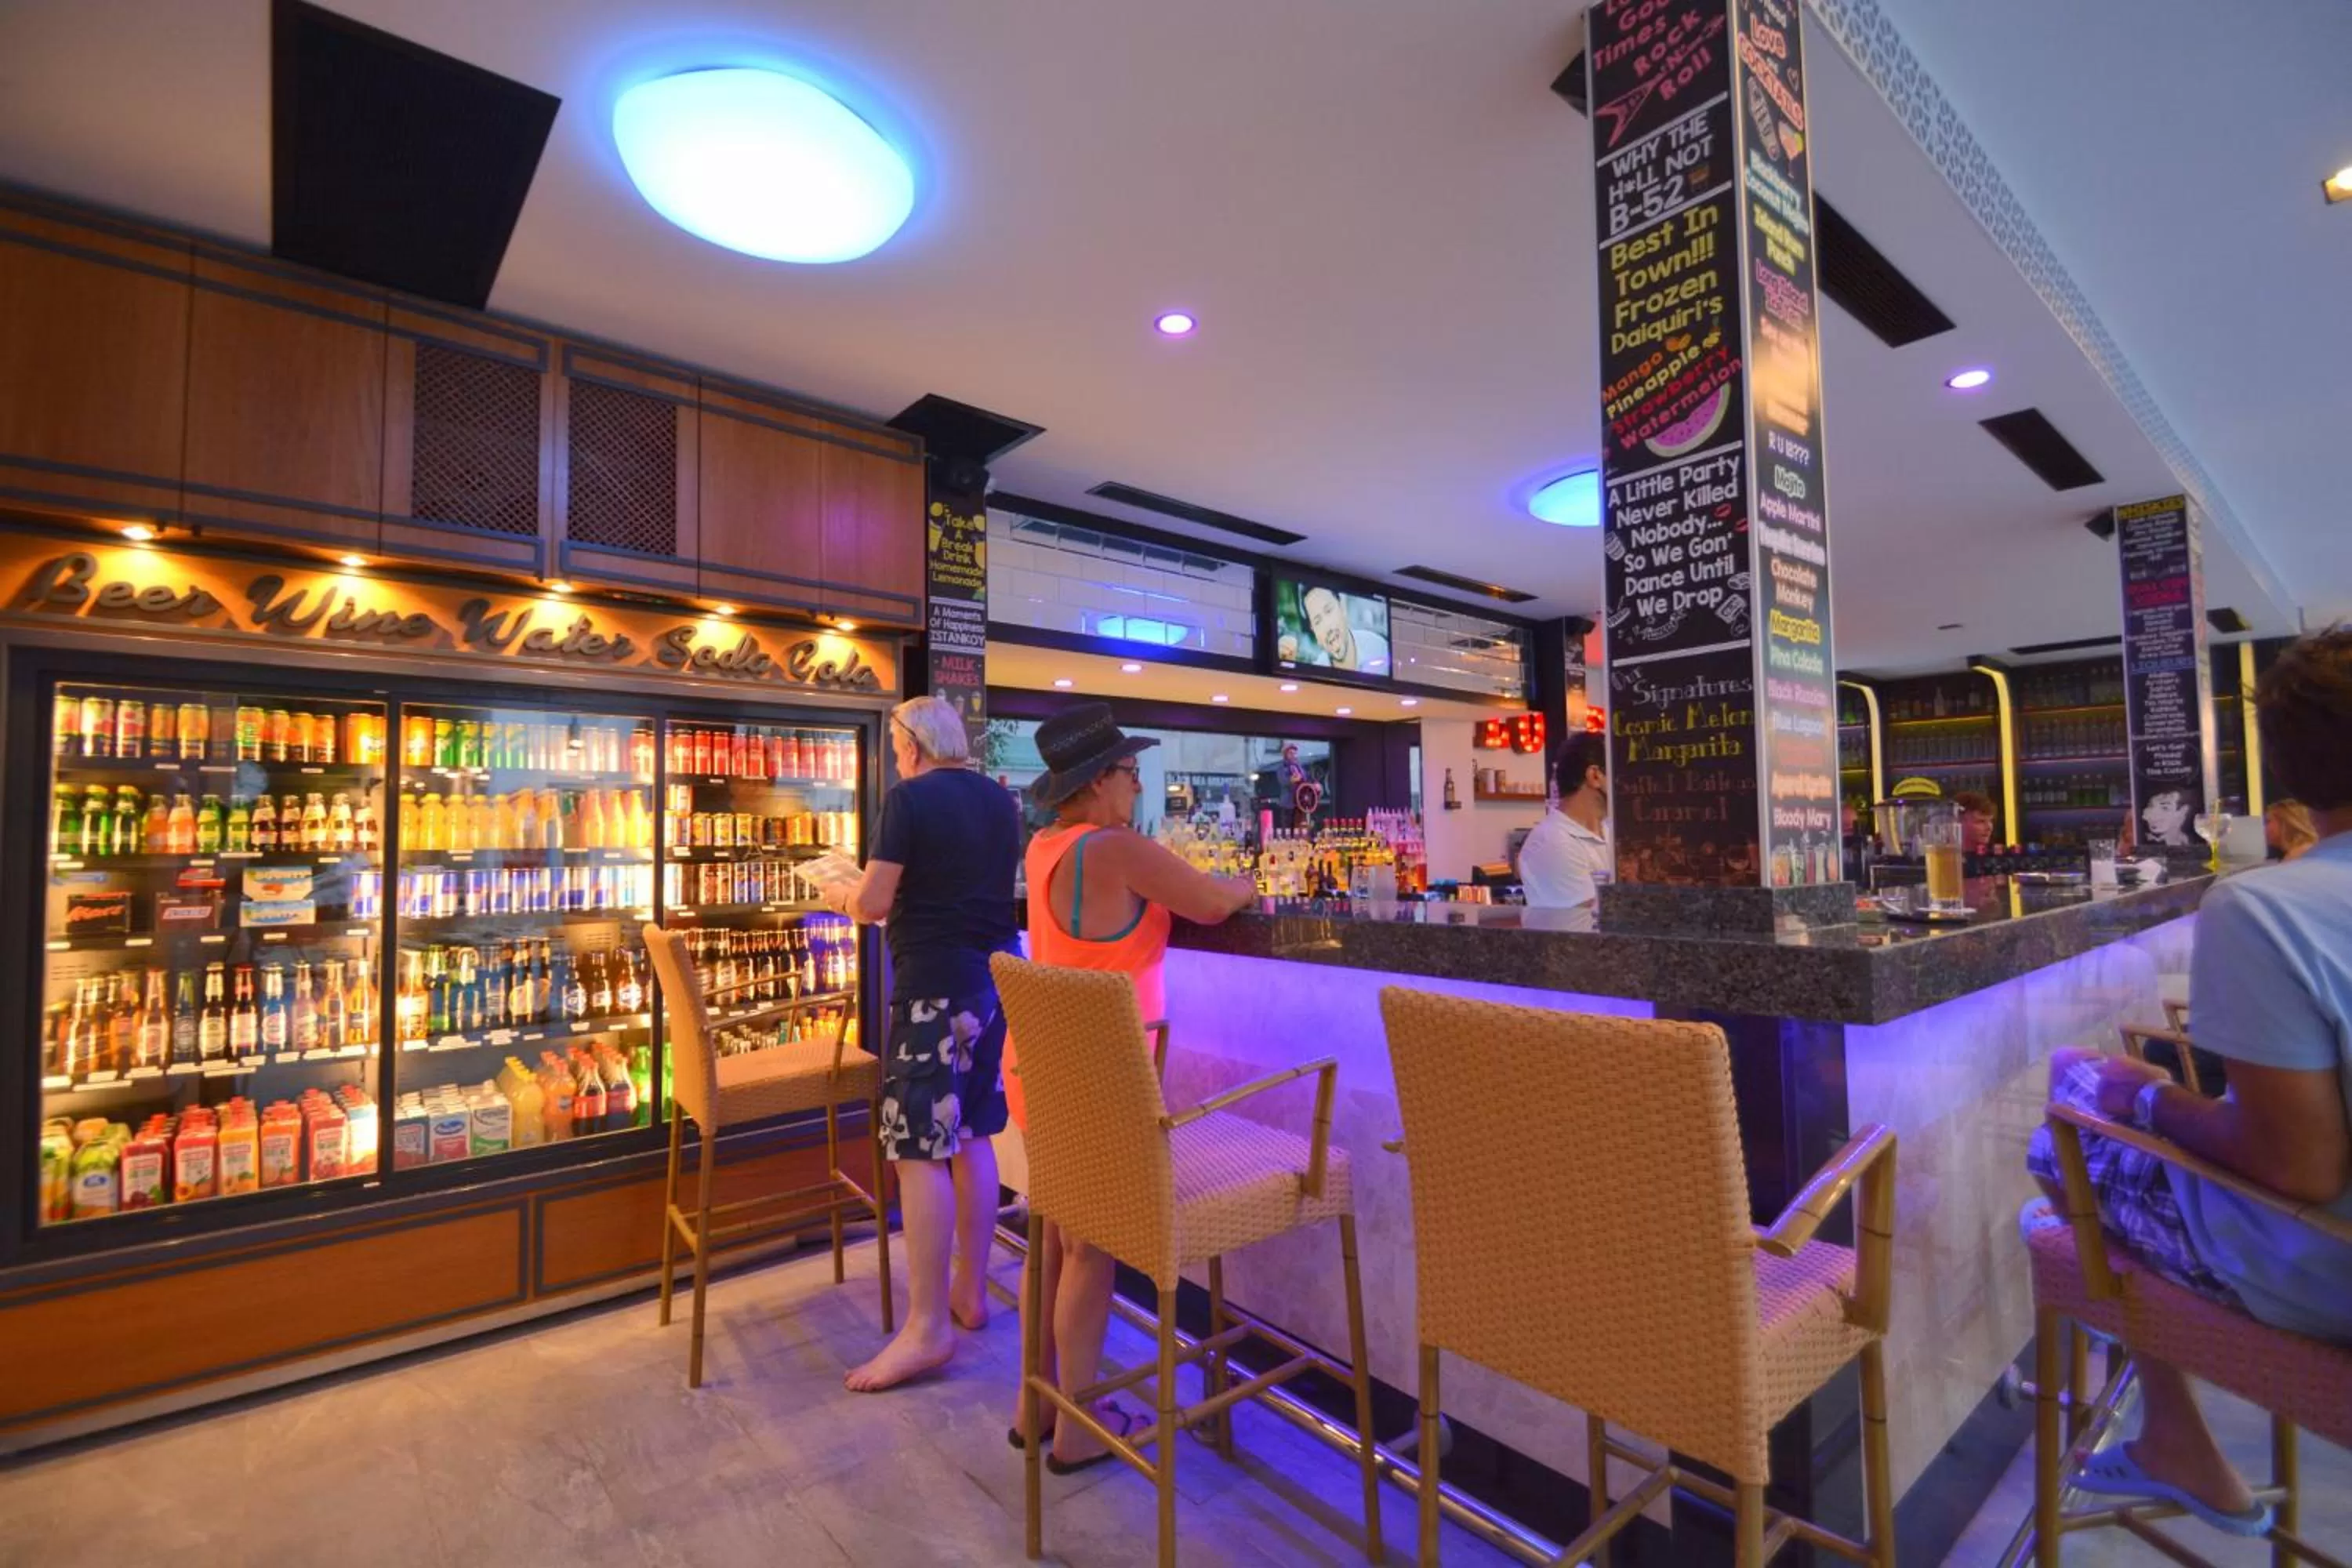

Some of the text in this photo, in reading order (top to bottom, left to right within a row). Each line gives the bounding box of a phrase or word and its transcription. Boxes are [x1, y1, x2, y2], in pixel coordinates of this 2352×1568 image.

[1592, 15, 1668, 71] Times
[1658, 46, 1713, 101] Roll
[1612, 111, 1710, 178] WHY THE
[1665, 134, 1715, 174] NOT
[1610, 174, 1686, 236] B-52
[1610, 220, 1675, 270] Best
[1683, 205, 1719, 237] In
[1614, 232, 1715, 298] Town!!!
[1611, 296, 1723, 355] Daiquiri's
[1614, 270, 1719, 329] Frozen
[1602, 351, 1663, 401] Mango
[1606, 345, 1701, 420] Pineapple
[1608, 455, 1740, 509] A Little Party
[1616, 477, 1738, 529] Never Killed
[1760, 490, 1787, 520] Apple
[1624, 552, 1646, 573] So
[1651, 544, 1682, 568] We
[1631, 514, 1723, 549] Nobody...
[1625, 554, 1735, 597] Dance Until
[1770, 557, 1817, 590] Chocolate
[26, 551, 874, 686] Beer Wine Water Soda Cola
[1636, 587, 1723, 618] We Drop
